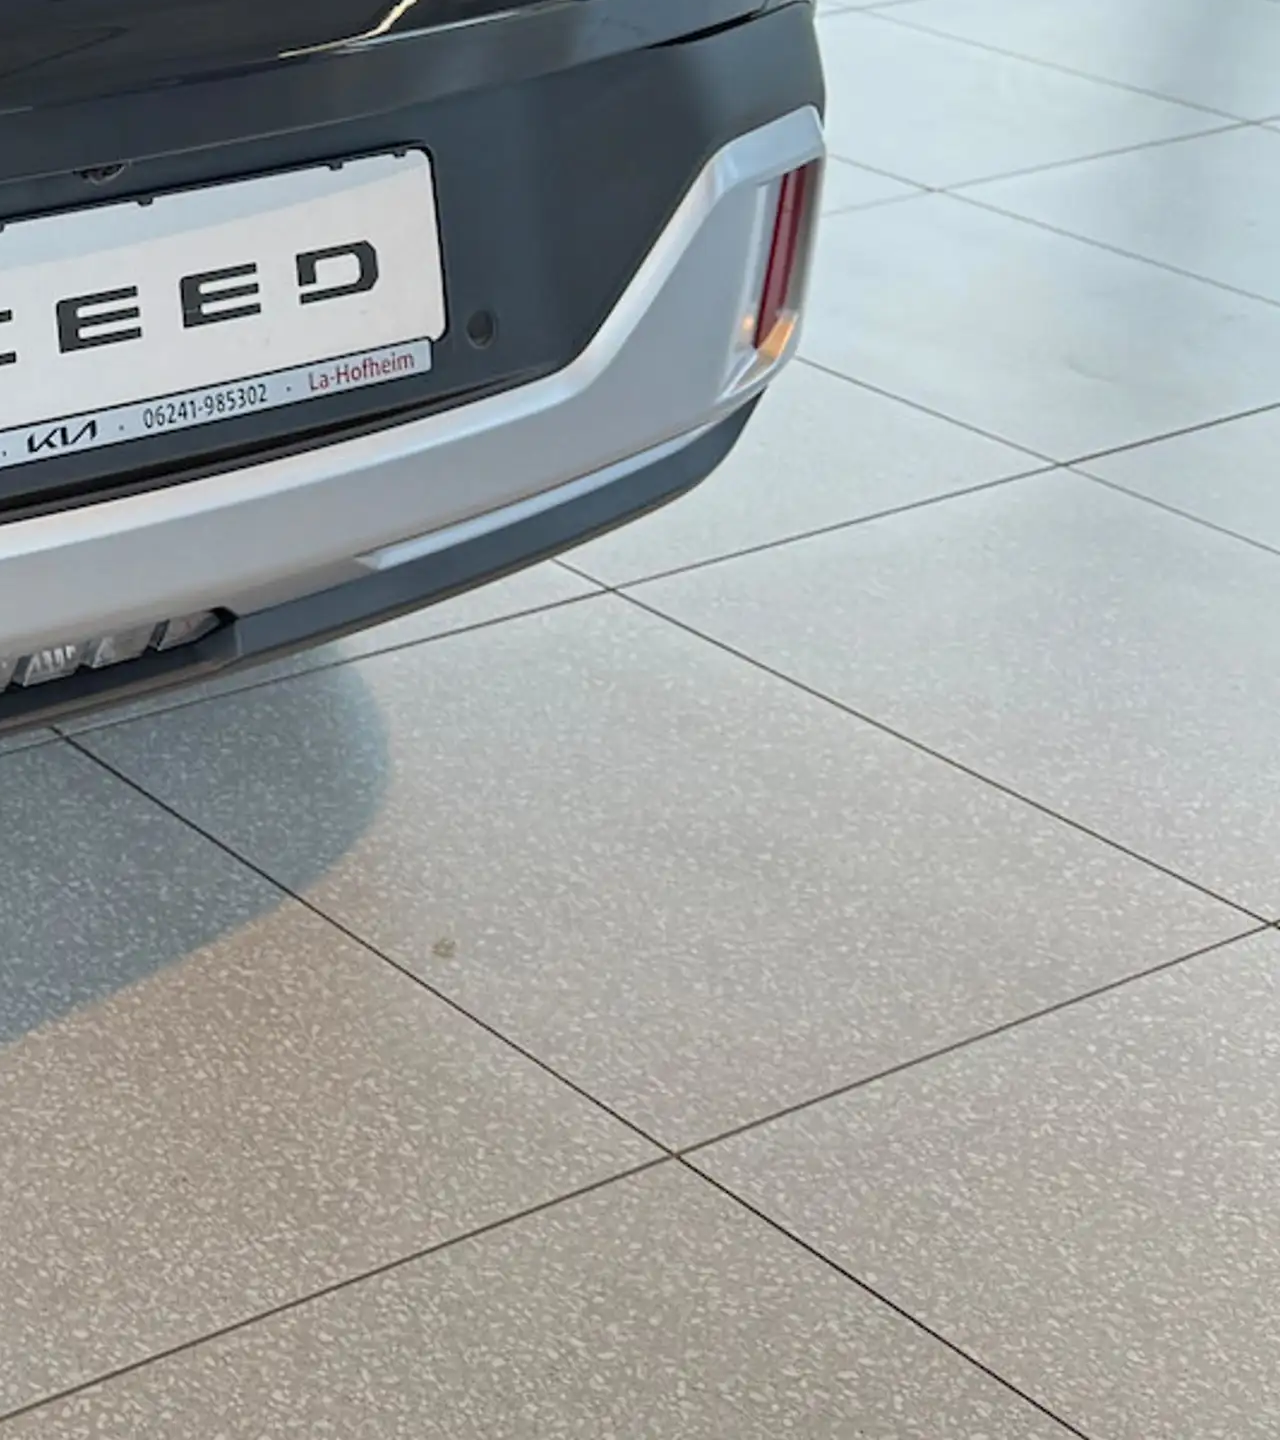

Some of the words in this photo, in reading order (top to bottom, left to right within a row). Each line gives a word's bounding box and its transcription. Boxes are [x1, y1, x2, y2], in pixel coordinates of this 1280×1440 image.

[26, 418, 98, 455] KIA
[142, 383, 270, 430] 06241-985302
[308, 351, 416, 392] La-Hofheim
